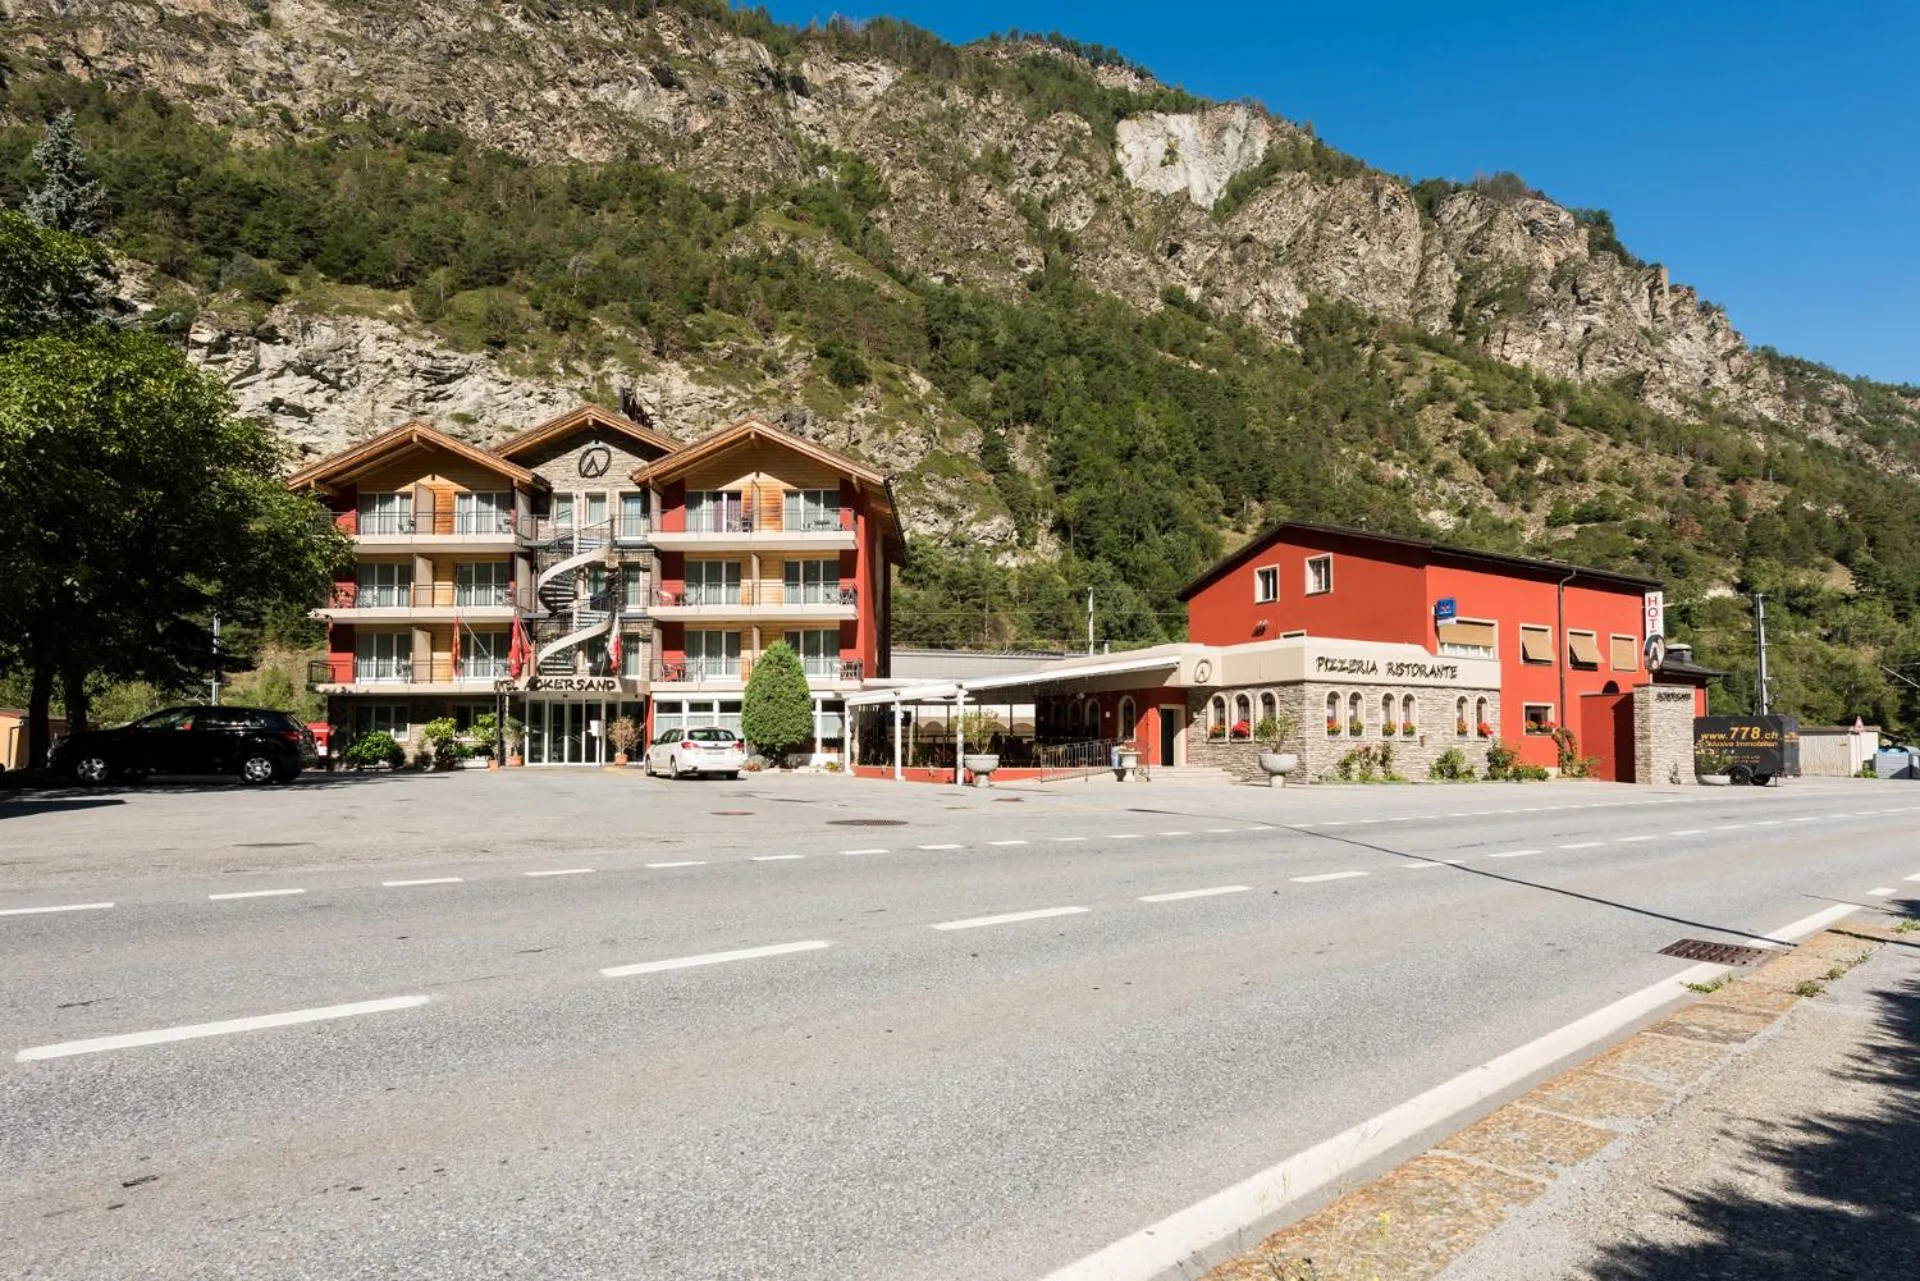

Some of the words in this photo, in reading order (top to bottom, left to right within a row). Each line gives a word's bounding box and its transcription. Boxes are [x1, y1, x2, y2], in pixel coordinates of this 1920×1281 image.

[1648, 596, 1657, 633] HOT
[1316, 656, 1378, 675] PIZZERIA
[1385, 661, 1458, 679] RISTORANTE
[524, 677, 617, 691] ACKERSAND
[1700, 726, 1779, 740] www.778.ch
